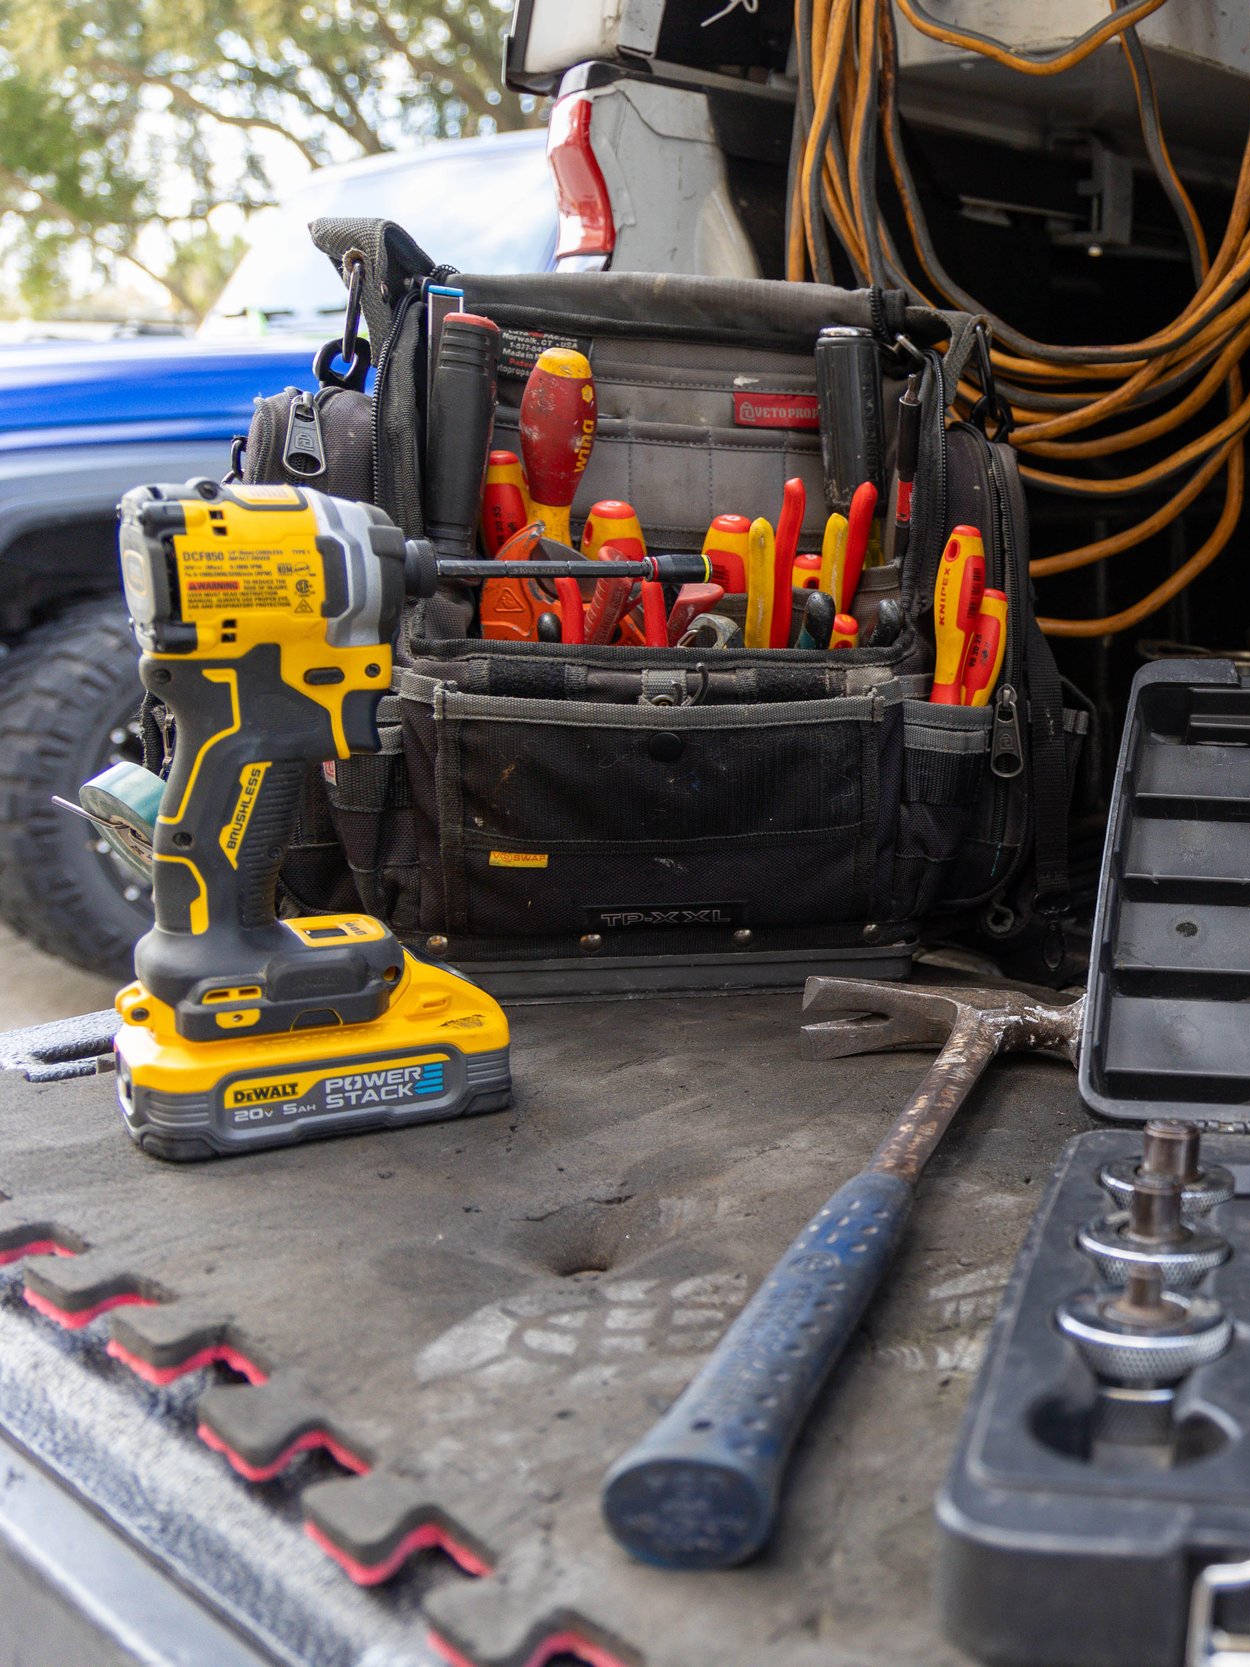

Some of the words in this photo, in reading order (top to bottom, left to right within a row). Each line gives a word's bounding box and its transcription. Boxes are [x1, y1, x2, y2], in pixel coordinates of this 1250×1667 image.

[197, 581, 239, 590] WARNING
[938, 567, 952, 626] KNIPEX
[226, 768, 261, 850] BRUSHLESS
[325, 1066, 422, 1094] POWER
[326, 1082, 414, 1110] STACK
